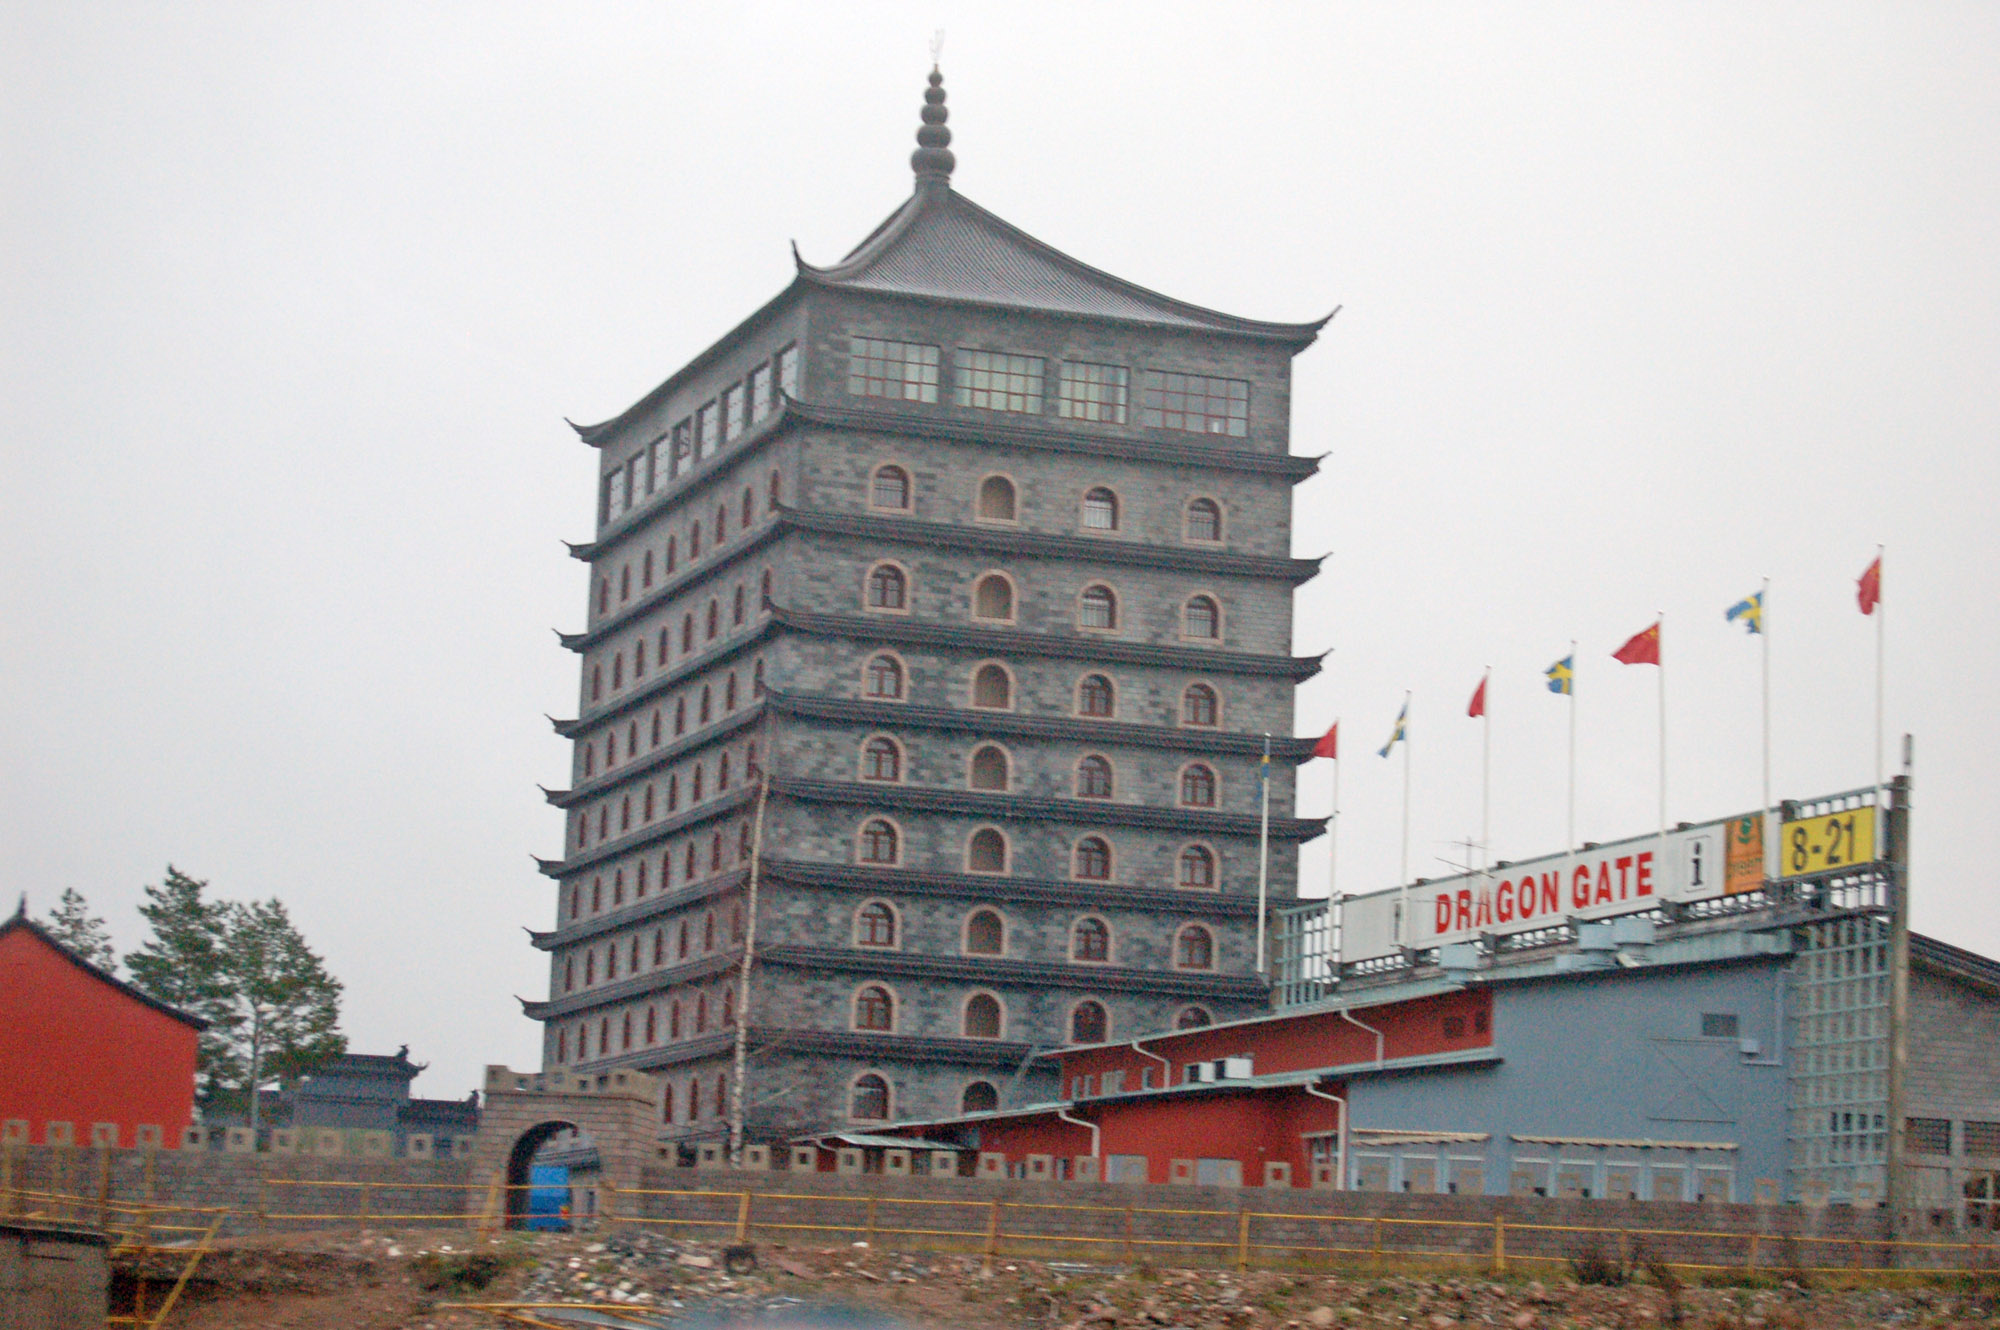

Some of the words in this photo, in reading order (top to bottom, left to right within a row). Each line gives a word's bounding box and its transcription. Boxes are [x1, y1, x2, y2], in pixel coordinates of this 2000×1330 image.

[1691, 841, 1705, 888] i
[1791, 814, 1855, 872] 8-21
[1435, 871, 1559, 934] DRAGON
[1572, 851, 1654, 909] GATE
